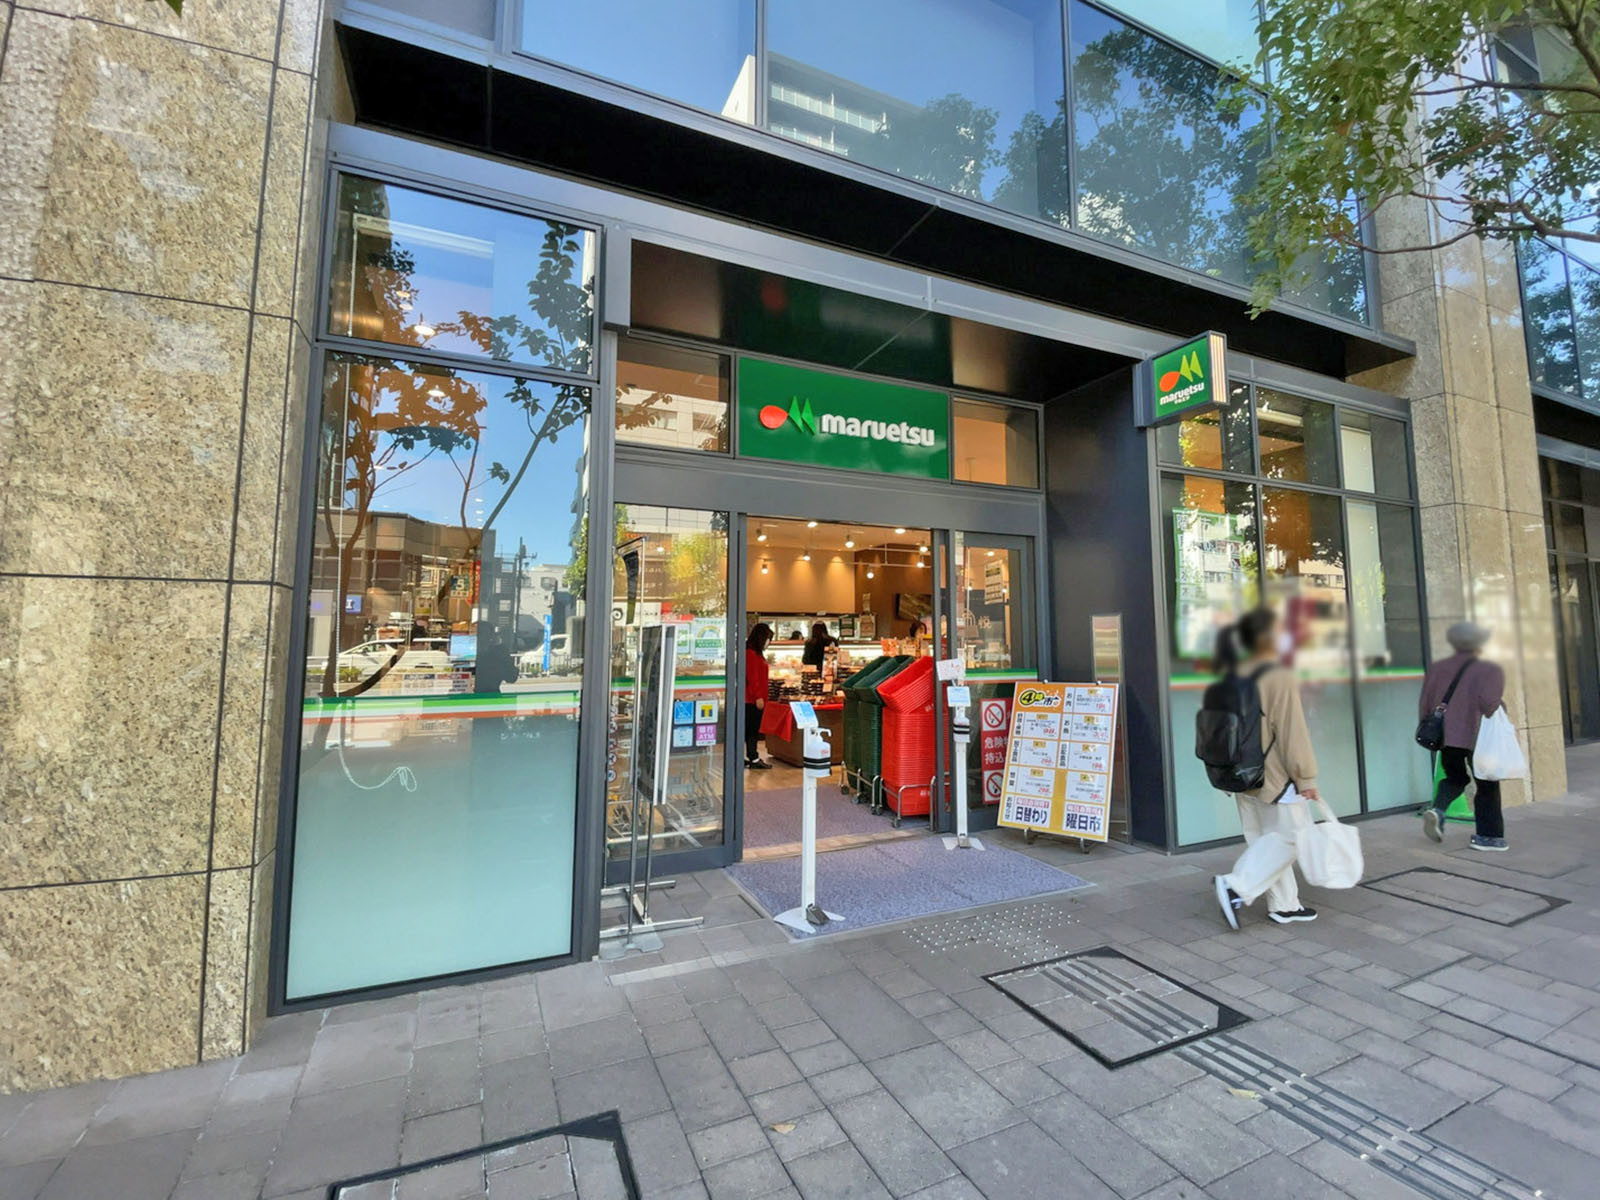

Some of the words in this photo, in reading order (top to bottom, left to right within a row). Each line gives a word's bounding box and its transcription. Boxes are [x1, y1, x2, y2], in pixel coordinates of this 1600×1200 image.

[1160, 382, 1205, 405] maruetsu
[822, 413, 935, 446] maruetsu
[1015, 806, 1048, 824] 日替わり
[1065, 812, 1102, 833] 曜日市
